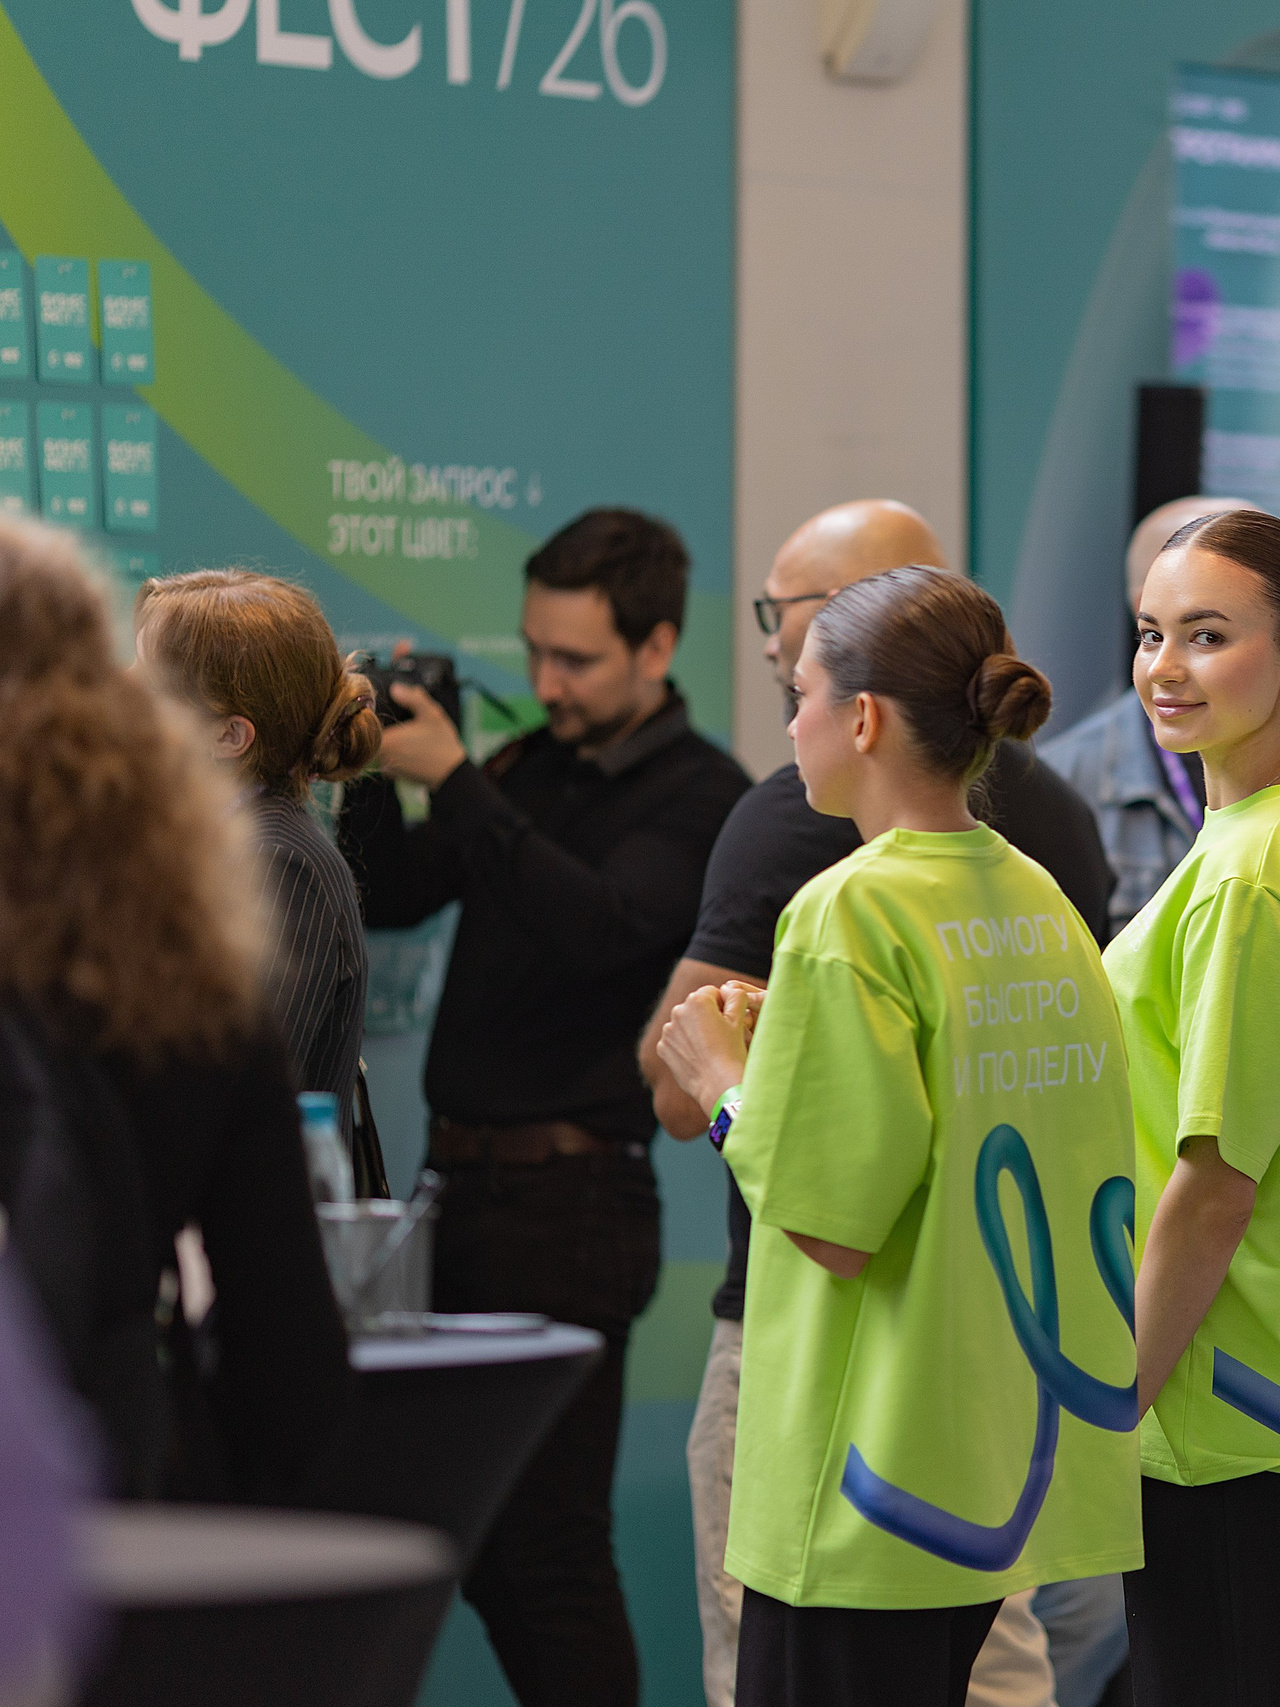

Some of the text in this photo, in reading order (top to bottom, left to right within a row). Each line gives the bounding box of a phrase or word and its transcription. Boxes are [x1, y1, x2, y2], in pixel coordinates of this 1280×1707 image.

[935, 914, 1069, 961] ПОМОГУ
[962, 977, 1080, 1028] БЫСТРО
[953, 1040, 1107, 1098] И ПО ДЕЛУ
